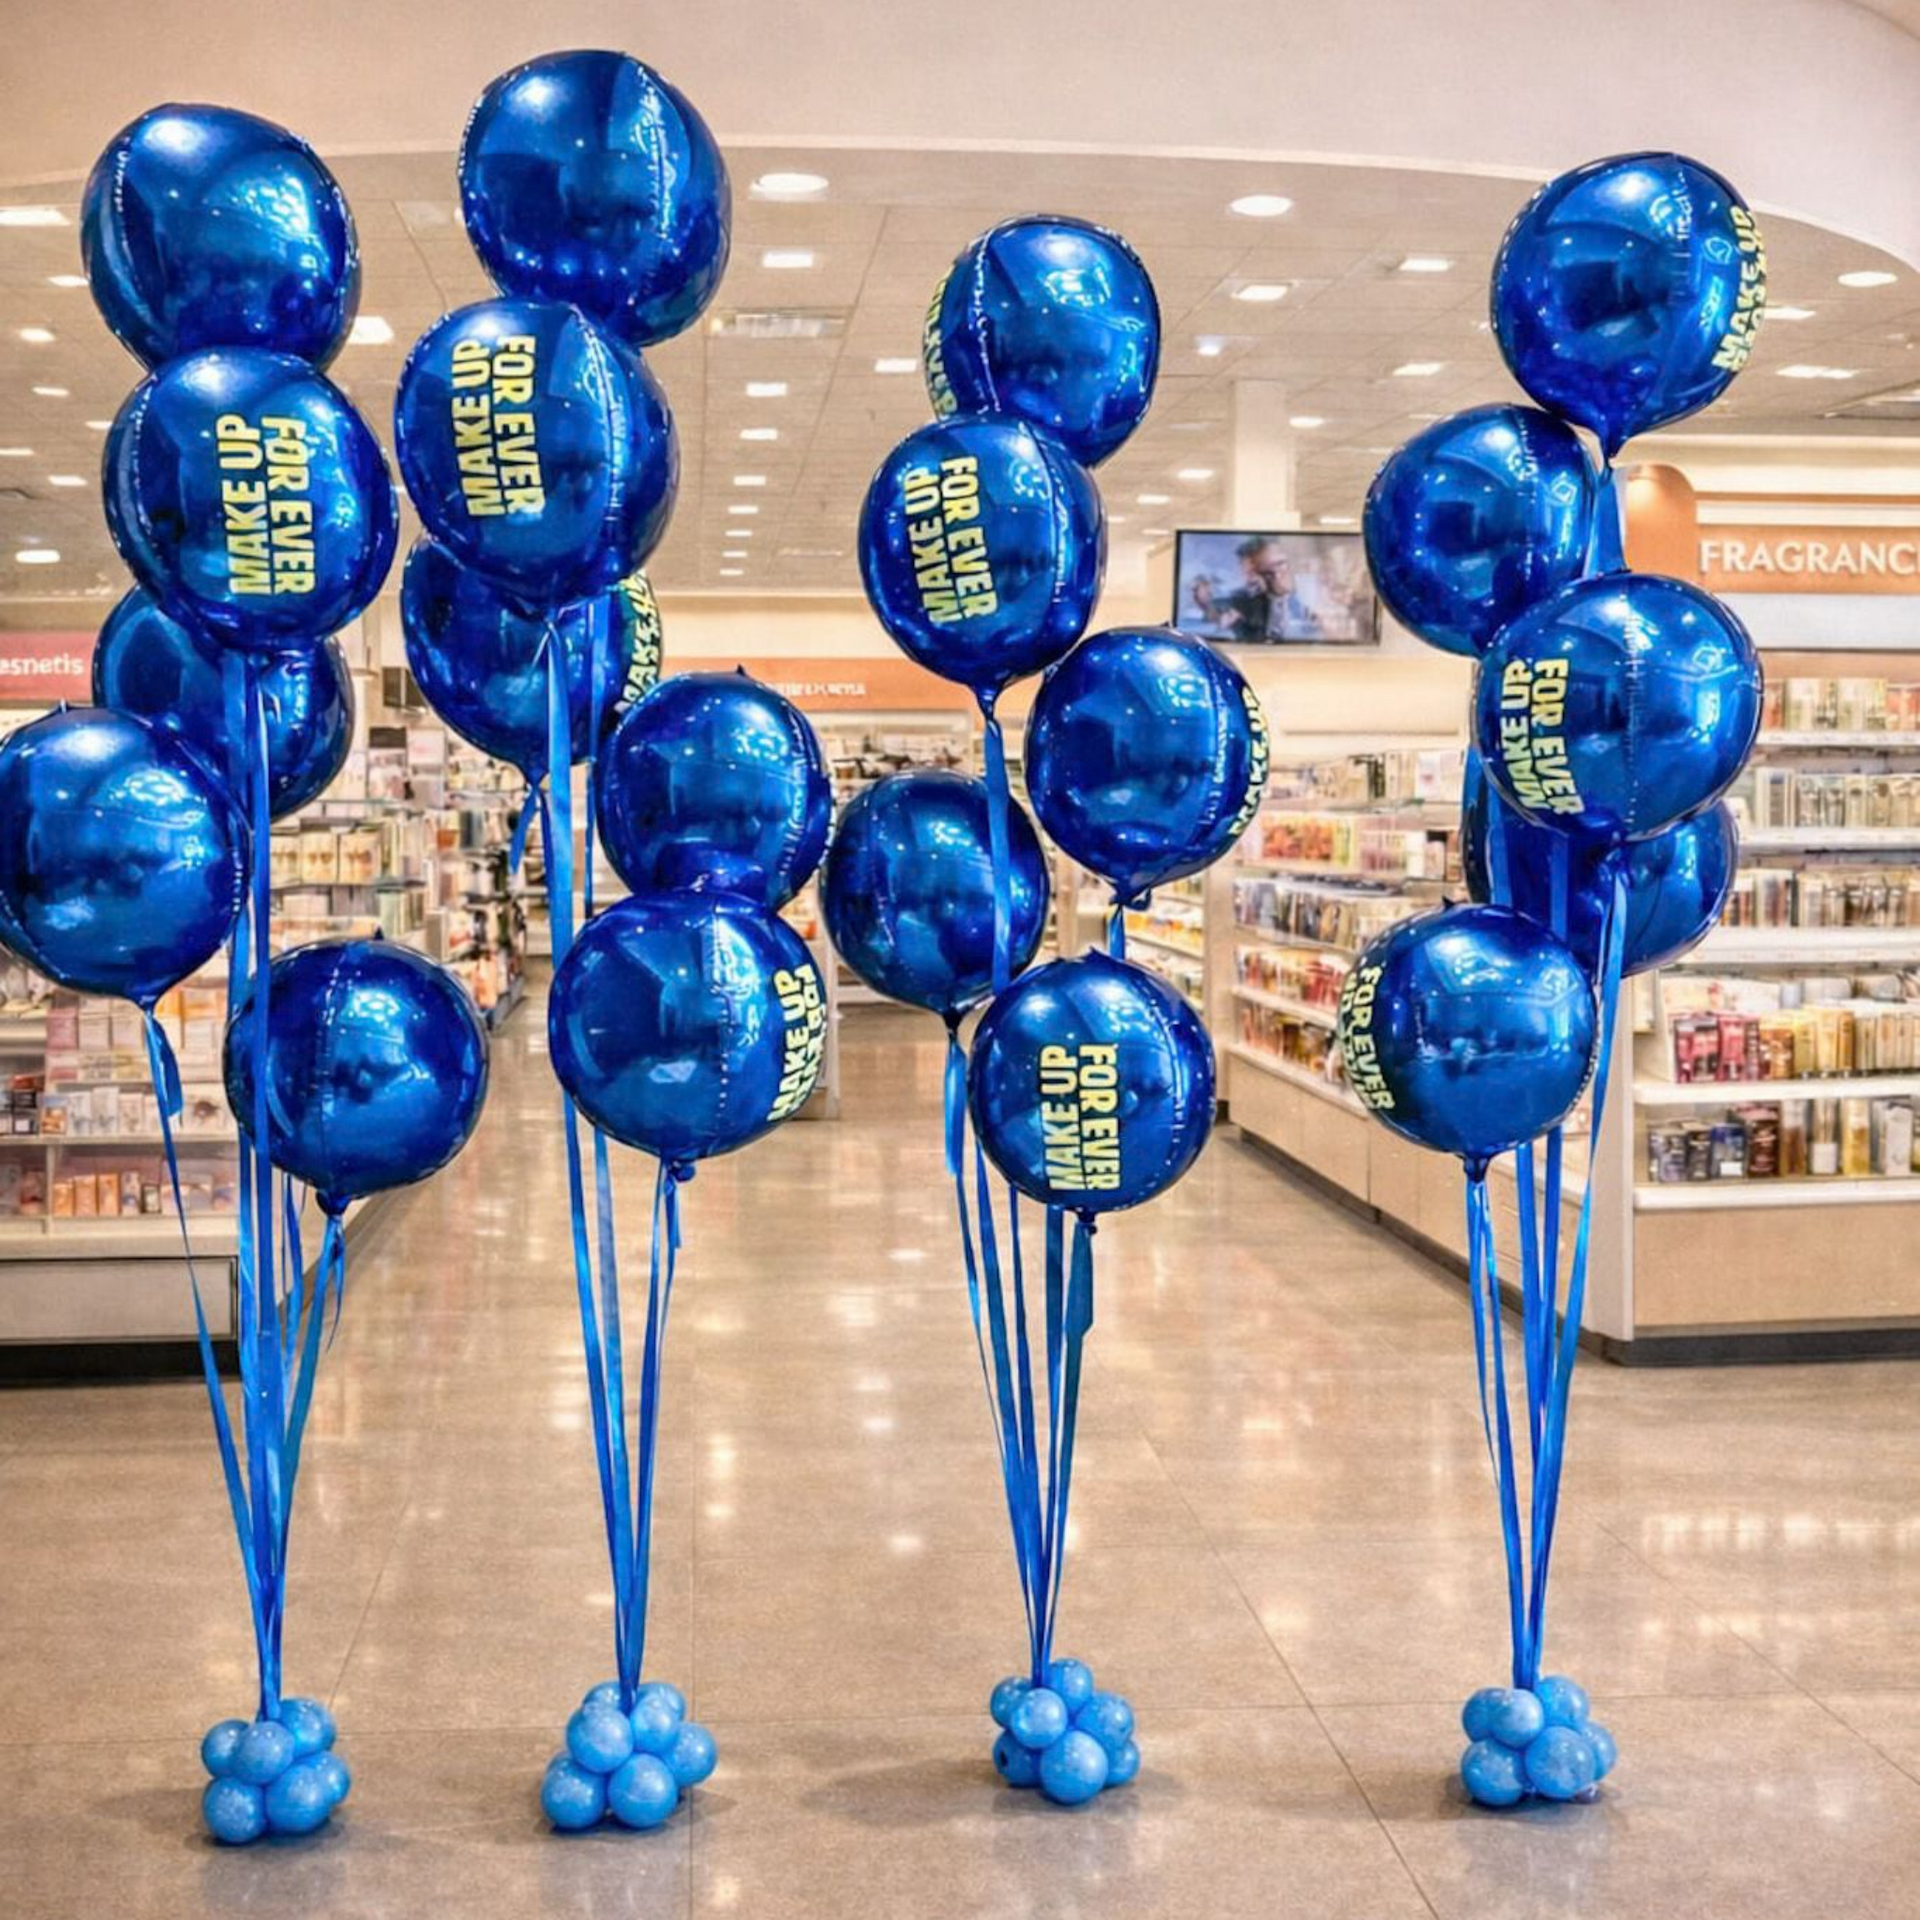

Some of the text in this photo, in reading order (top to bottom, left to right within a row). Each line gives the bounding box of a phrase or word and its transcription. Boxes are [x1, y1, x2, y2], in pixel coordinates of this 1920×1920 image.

[1711, 205, 1758, 369] MAKE UP
[451, 338, 506, 516] MAKE UP
[492, 335, 546, 514] FOR EVER
[903, 466, 941, 515] UP
[940, 456, 980, 524] FOR
[216, 413, 272, 594] MAKE UP
[261, 416, 315, 594] FOR EVER
[908, 516, 963, 623] MAKE
[948, 526, 998, 619] EVER
[1700, 539, 1920, 576] FRAGRANC
[1500, 659, 1552, 809] MAKE UP
[1531, 658, 1585, 815] FOR EVER
[766, 969, 810, 1122] MAKE UP
[1352, 966, 1396, 1110] FOR EVER
[1040, 1044, 1087, 1190] MAKE UP
[1079, 1043, 1120, 1190] FOR EVER
